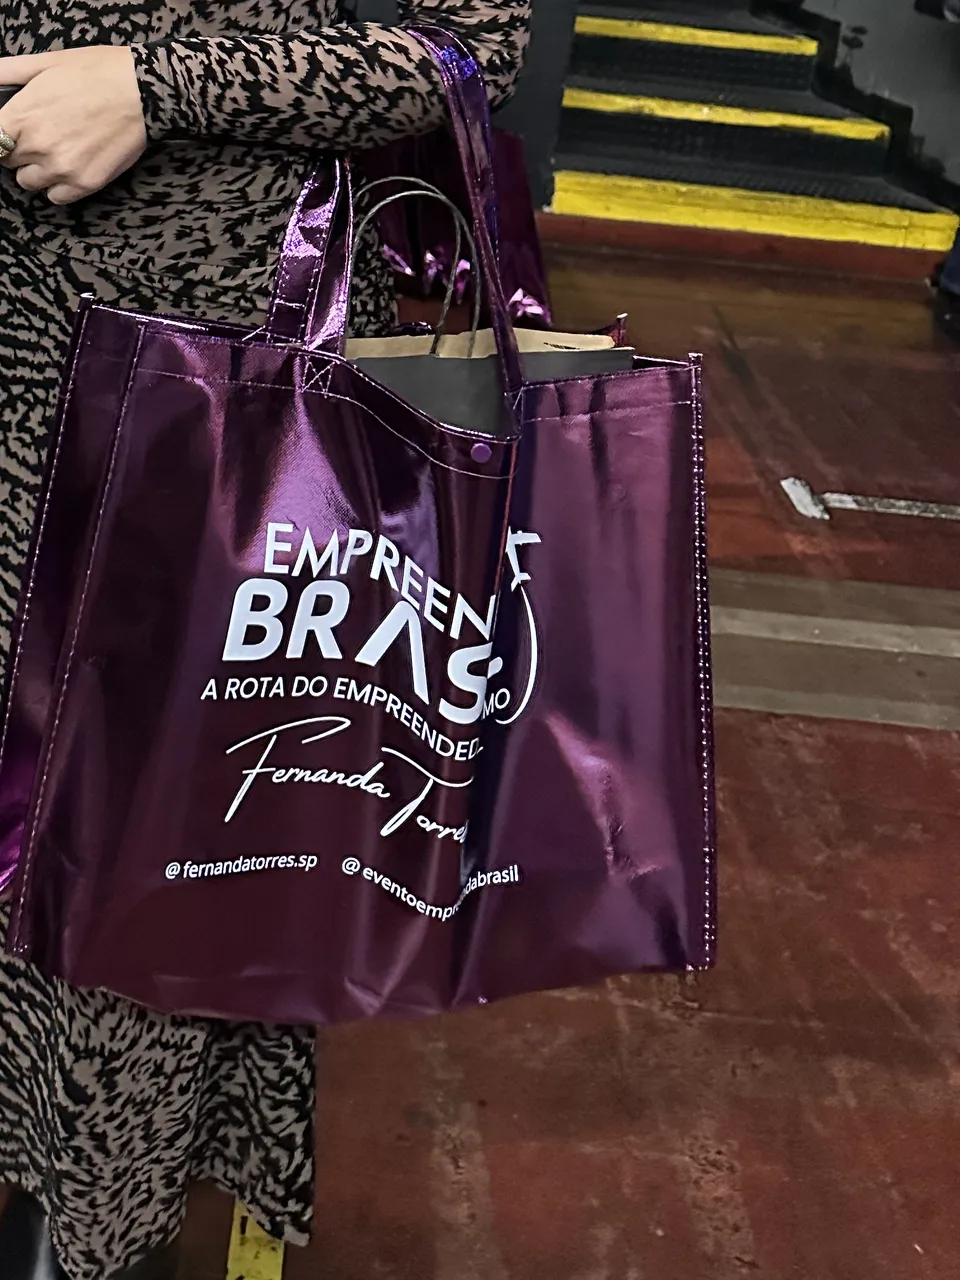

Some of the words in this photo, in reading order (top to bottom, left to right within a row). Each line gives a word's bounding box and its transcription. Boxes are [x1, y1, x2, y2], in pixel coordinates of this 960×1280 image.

[263, 522, 497, 641] EMPREEN
[200, 678, 218, 701] A
[224, 676, 285, 700] ROTA
[291, 675, 328, 697] DO
[222, 578, 503, 724] BRAS
[225, 716, 390, 823] Fernanda
[381, 746, 474, 843] Torre
